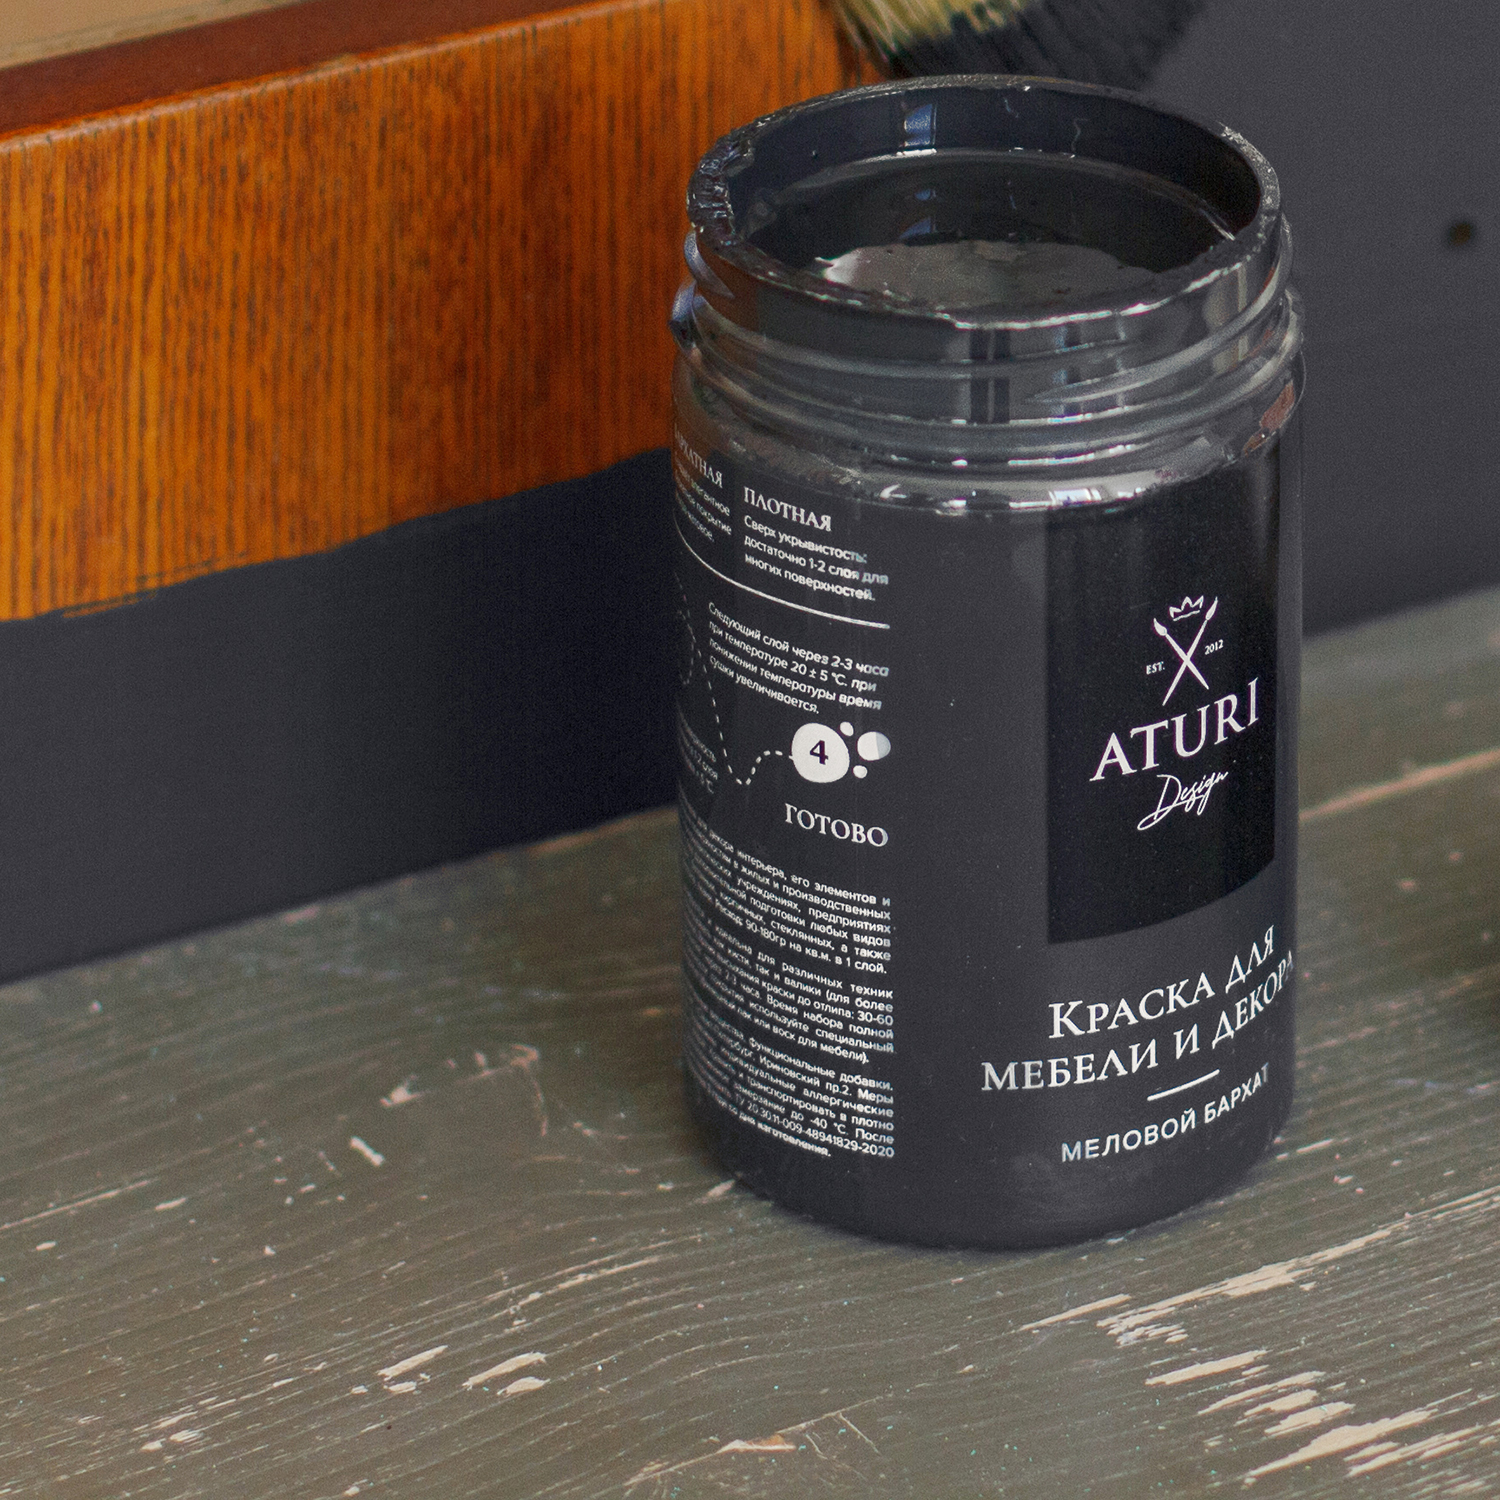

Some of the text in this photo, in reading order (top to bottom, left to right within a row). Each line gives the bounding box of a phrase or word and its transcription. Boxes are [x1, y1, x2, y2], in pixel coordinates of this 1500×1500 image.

[743, 486, 832, 530] ПЛОТНАЯ
[743, 515, 775, 539] Сверх
[744, 535, 889, 585] достаточно 1-2 слоя для
[744, 554, 875, 599] многих поверхностей.
[708, 601, 890, 677] Следующий слой через 2-3 часа
[709, 621, 722, 637] при
[723, 632, 788, 669] температуре
[789, 660, 807, 676] 20
[820, 669, 828, 682] 5
[850, 678, 877, 693] при
[1146, 639, 1224, 675] EST. 2012
[709, 638, 881, 710] понижении температуры время
[709, 655, 819, 712] сушки увеличивается.
[1089, 677, 1259, 781] ATURI
[809, 739, 830, 766] 4
[1137, 772, 1229, 831] Design
[785, 803, 889, 848] ГОТОВО
[772, 880, 780, 890] и
[783, 886, 891, 918] производственных
[790, 873, 810, 887] его
[814, 882, 876, 903] элементов
[882, 897, 890, 906] и
[750, 898, 891, 947] подготовки любых видов
[770, 921, 835, 948] стеклянных,
[854, 948, 891, 961] также
[808, 908, 891, 932] предприятиях
[757, 951, 775, 966] для
[782, 963, 842, 986] различных
[850, 984, 893, 998] техник
[789, 941, 802, 952] на
[834, 956, 842, 964] в
[846, 957, 850, 966] 1
[854, 959, 887, 974] слой.
[1225, 924, 1275, 995] ДЛЯ
[756, 963, 769, 976] так
[773, 972, 780, 981] и
[784, 977, 821, 994] валики
[826, 989, 850, 1004] (для
[854, 998, 893, 1012] более
[761, 981, 795, 999] краски
[797, 995, 811, 1006] до
[813, 1001, 854, 1018] отлипа:
[857, 1010, 894, 1026] 30-60
[766, 995, 798, 1014] Время
[803, 1012, 843, 1028] набора
[848, 1024, 894, 1040] полной
[797, 1036, 817, 1049] для
[819, 1044, 868, 1063] мебели).
[815, 1029, 894, 1053] специальный
[981, 1038, 1160, 1092] МЕБЕЛИ
[1172, 1023, 1201, 1061] И
[803, 1090, 894, 1118] аллергические
[825, 1081, 851, 1095] пр.2.
[858, 1090, 894, 1104] Меры
[839, 1074, 893, 1090] добавки.
[790, 1111, 804, 1122] до
[810, 1116, 827, 1129] -40
[855, 1128, 894, 1145] После
[840, 1114, 846, 1122] в
[851, 1117, 894, 1133] плотно
[1062, 1062, 1269, 1163] МЕЛОВОЙ БАРХАТ
